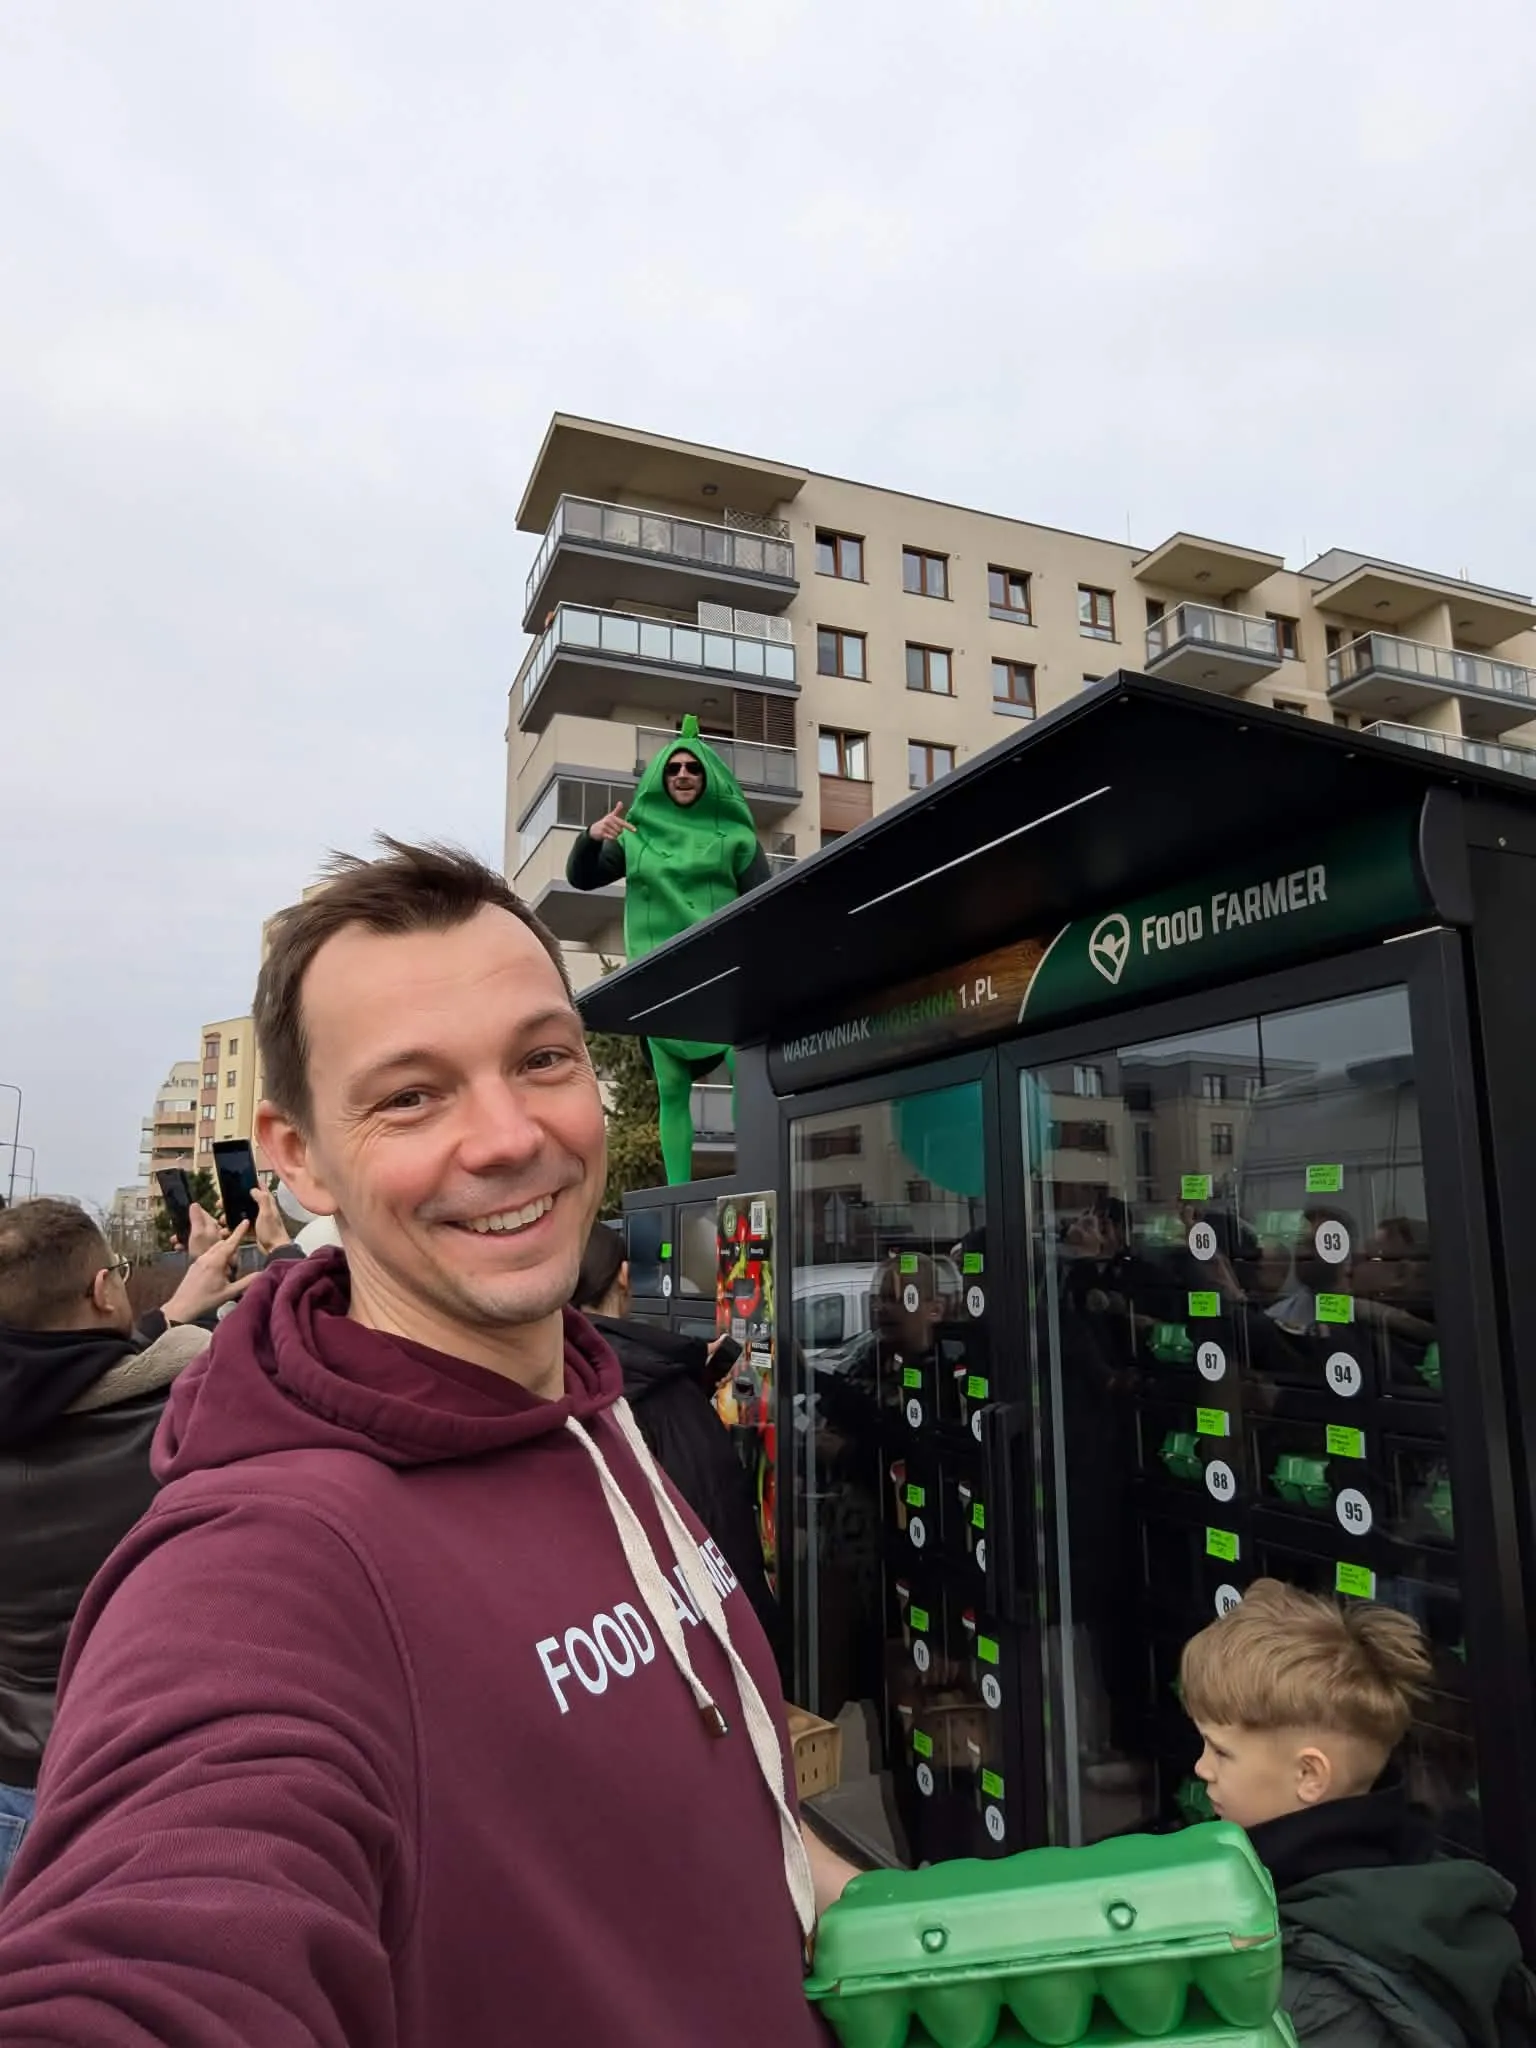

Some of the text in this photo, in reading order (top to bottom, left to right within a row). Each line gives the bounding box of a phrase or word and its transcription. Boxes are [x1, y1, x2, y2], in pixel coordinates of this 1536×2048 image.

[1142, 865, 1327, 955] FOOD FARMER
[1195, 1233, 1210, 1249] 86
[1323, 1233, 1341, 1250] 93
[1205, 1352, 1218, 1370] 87
[1334, 1365, 1352, 1384] 94
[1213, 1472, 1228, 1490] 88
[1344, 1501, 1363, 1522] 95
[535, 1602, 655, 1715] FOOD
